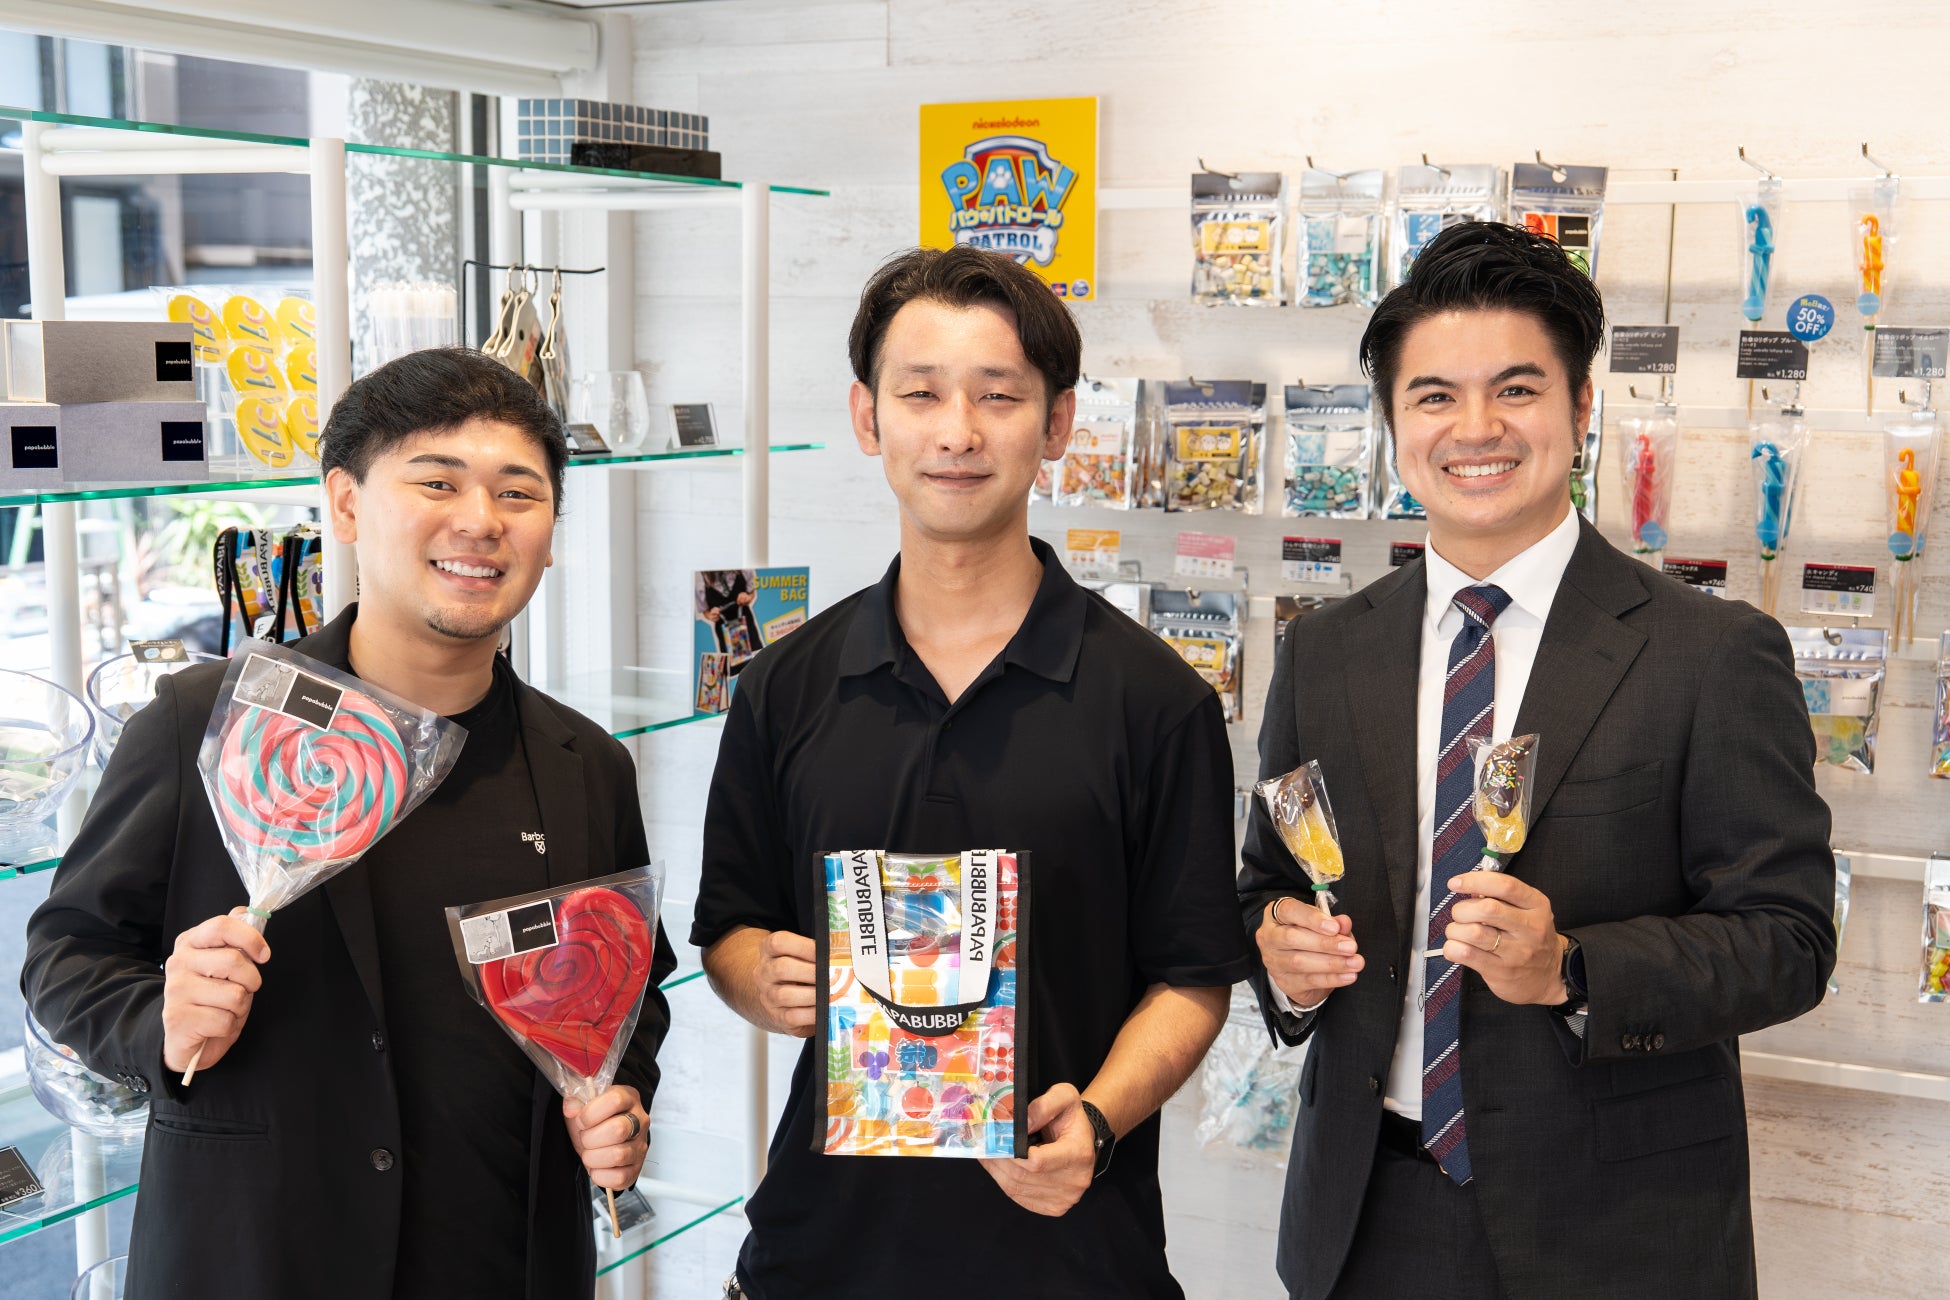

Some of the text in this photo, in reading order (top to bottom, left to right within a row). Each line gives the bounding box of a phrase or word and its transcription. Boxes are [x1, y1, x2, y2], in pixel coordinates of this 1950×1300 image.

[972, 117, 1040, 130] nickelodeon
[940, 155, 1078, 212] PAW
[969, 232, 1043, 250] PATROL
[1797, 308, 1825, 324] 50%
[1795, 321, 1820, 335] OFF
[1647, 363, 1675, 372] ¥1,280
[1776, 369, 1805, 379] ¥1,280
[1914, 367, 1945, 377] ¥1,280
[753, 575, 807, 588] SUMMER
[780, 588, 807, 601] BAG
[301, 694, 333, 711] papabubble
[522, 921, 552, 934] papabubble
[15, 1184, 37, 1197] ¥360
